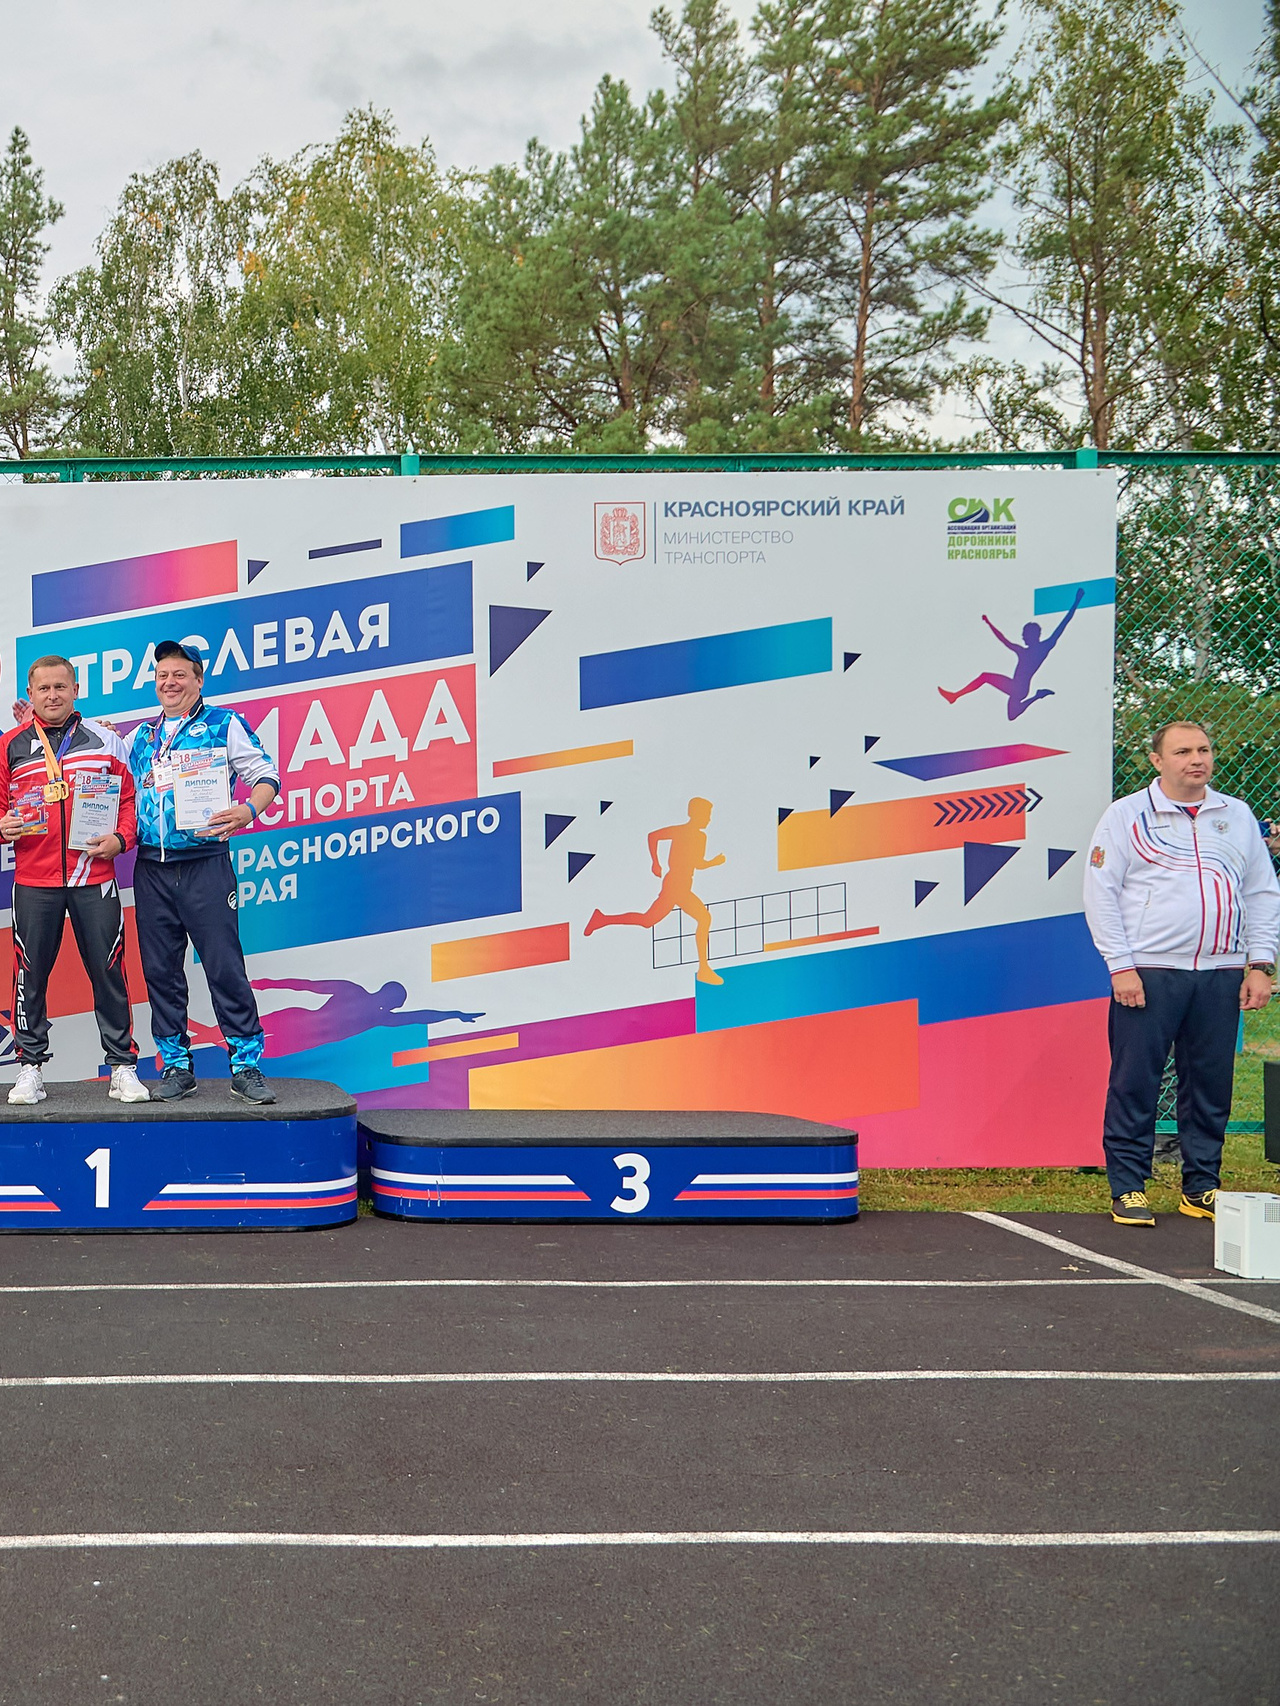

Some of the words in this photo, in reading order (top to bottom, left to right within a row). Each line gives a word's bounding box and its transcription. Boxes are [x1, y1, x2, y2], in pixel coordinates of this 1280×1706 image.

[663, 496, 840, 517] КРАСНОЯРСКИЙ
[848, 495, 905, 516] КРАЙ
[663, 530, 794, 545] МИНИСТЕРСТВО
[947, 535, 1016, 548] ДОРОЖНИКИ
[664, 551, 767, 564] ТРАНСПОРТА
[947, 548, 1016, 560] КРАСНОЯРЬЯ
[68, 602, 390, 700] ТРАСЛЕВАЯ
[185, 778, 218, 788] ДИПЛОМ
[81, 801, 109, 811] ДИПЛОМ
[230, 807, 501, 875] РАСНОЯРСКОГО
[237, 873, 298, 908] РАЯ
[84, 1148, 110, 1208] 1
[610, 1153, 650, 1214] 3
